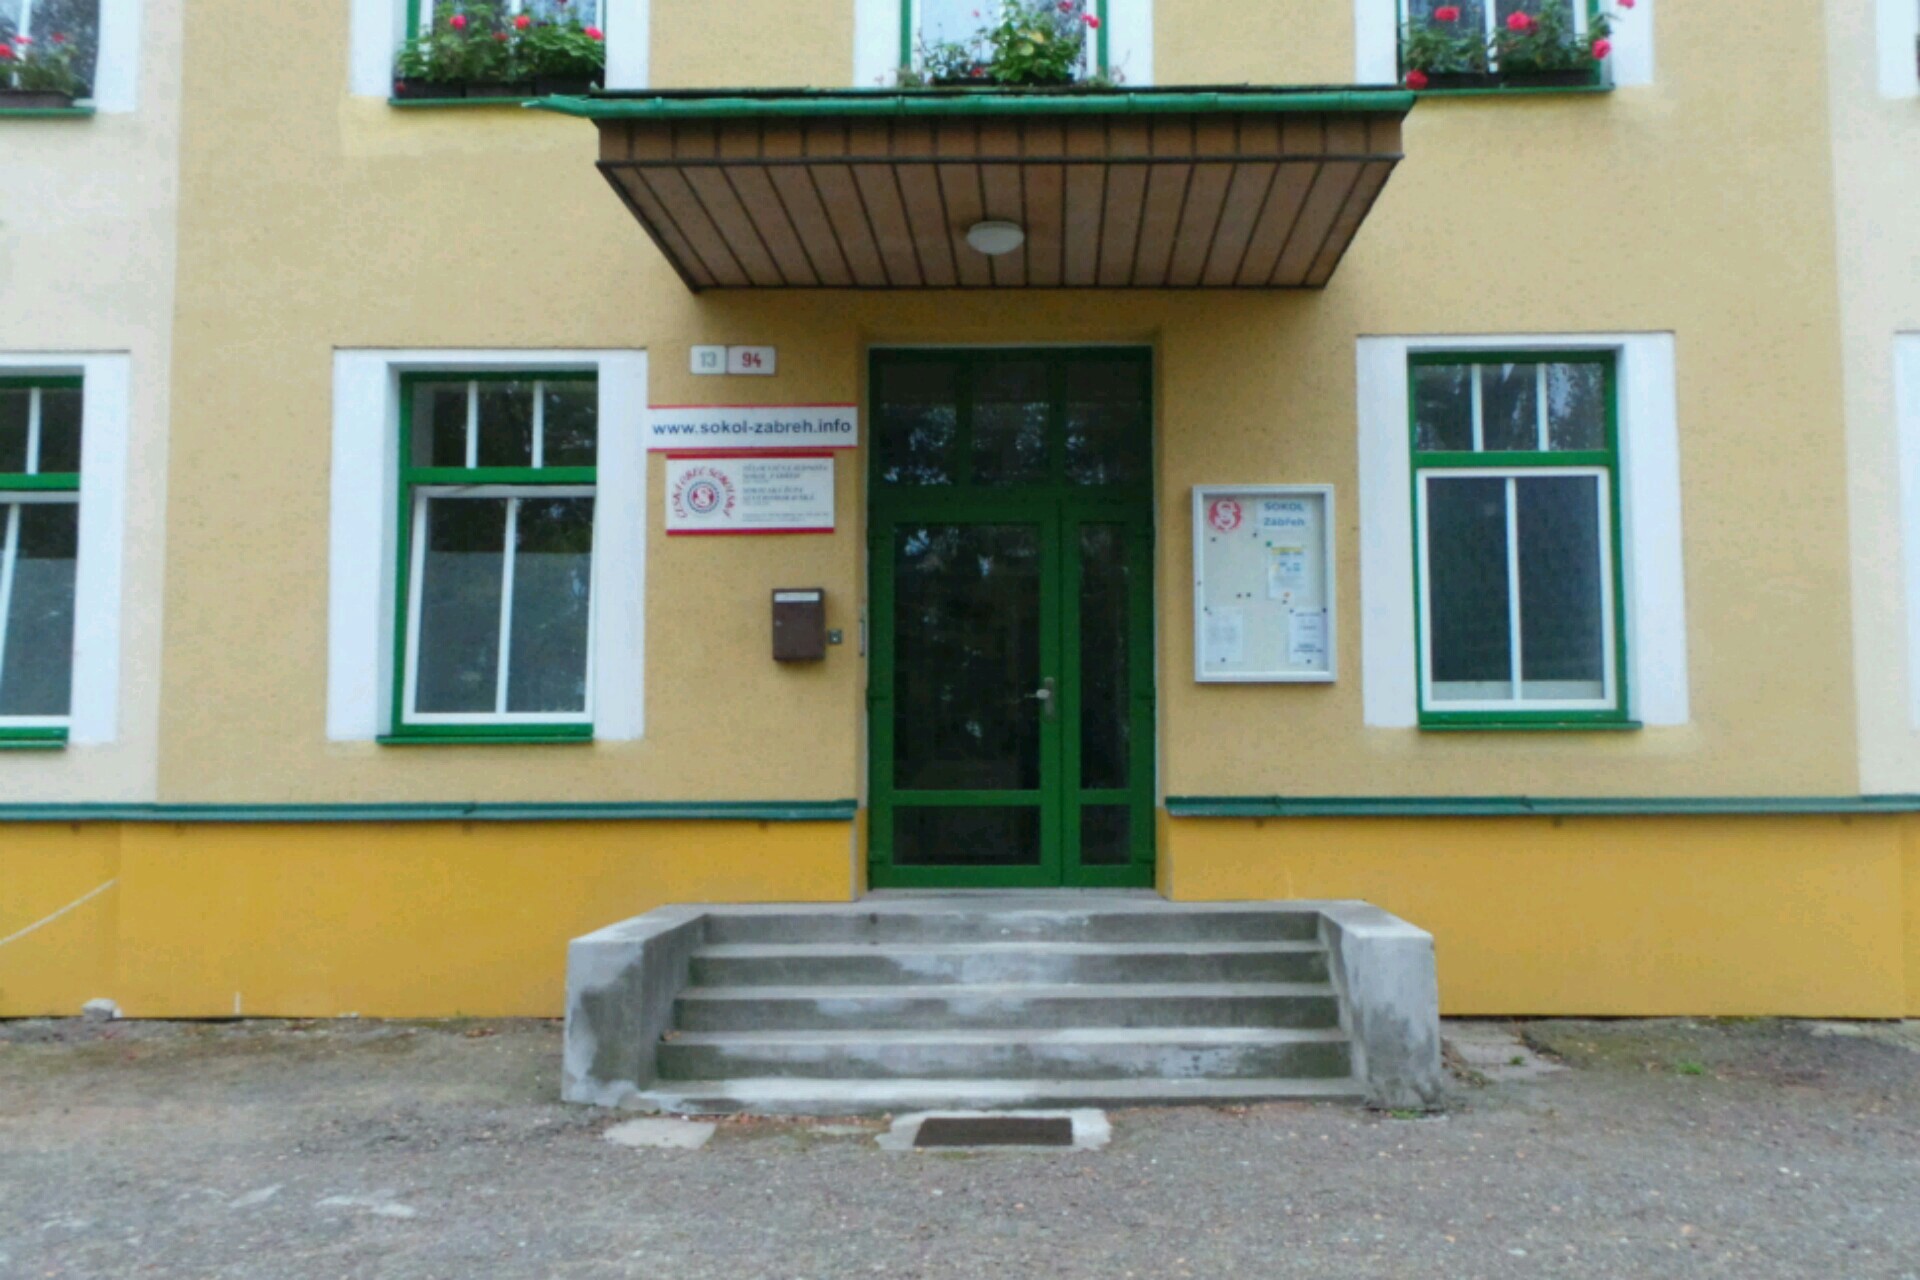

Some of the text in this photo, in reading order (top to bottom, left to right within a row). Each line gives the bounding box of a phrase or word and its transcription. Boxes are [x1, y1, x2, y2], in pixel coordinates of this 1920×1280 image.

[700, 351, 717, 368] 13
[741, 351, 762, 368] 94
[652, 418, 852, 435] www.sokol-zabreh.info
[1263, 502, 1304, 512] SOKOL
